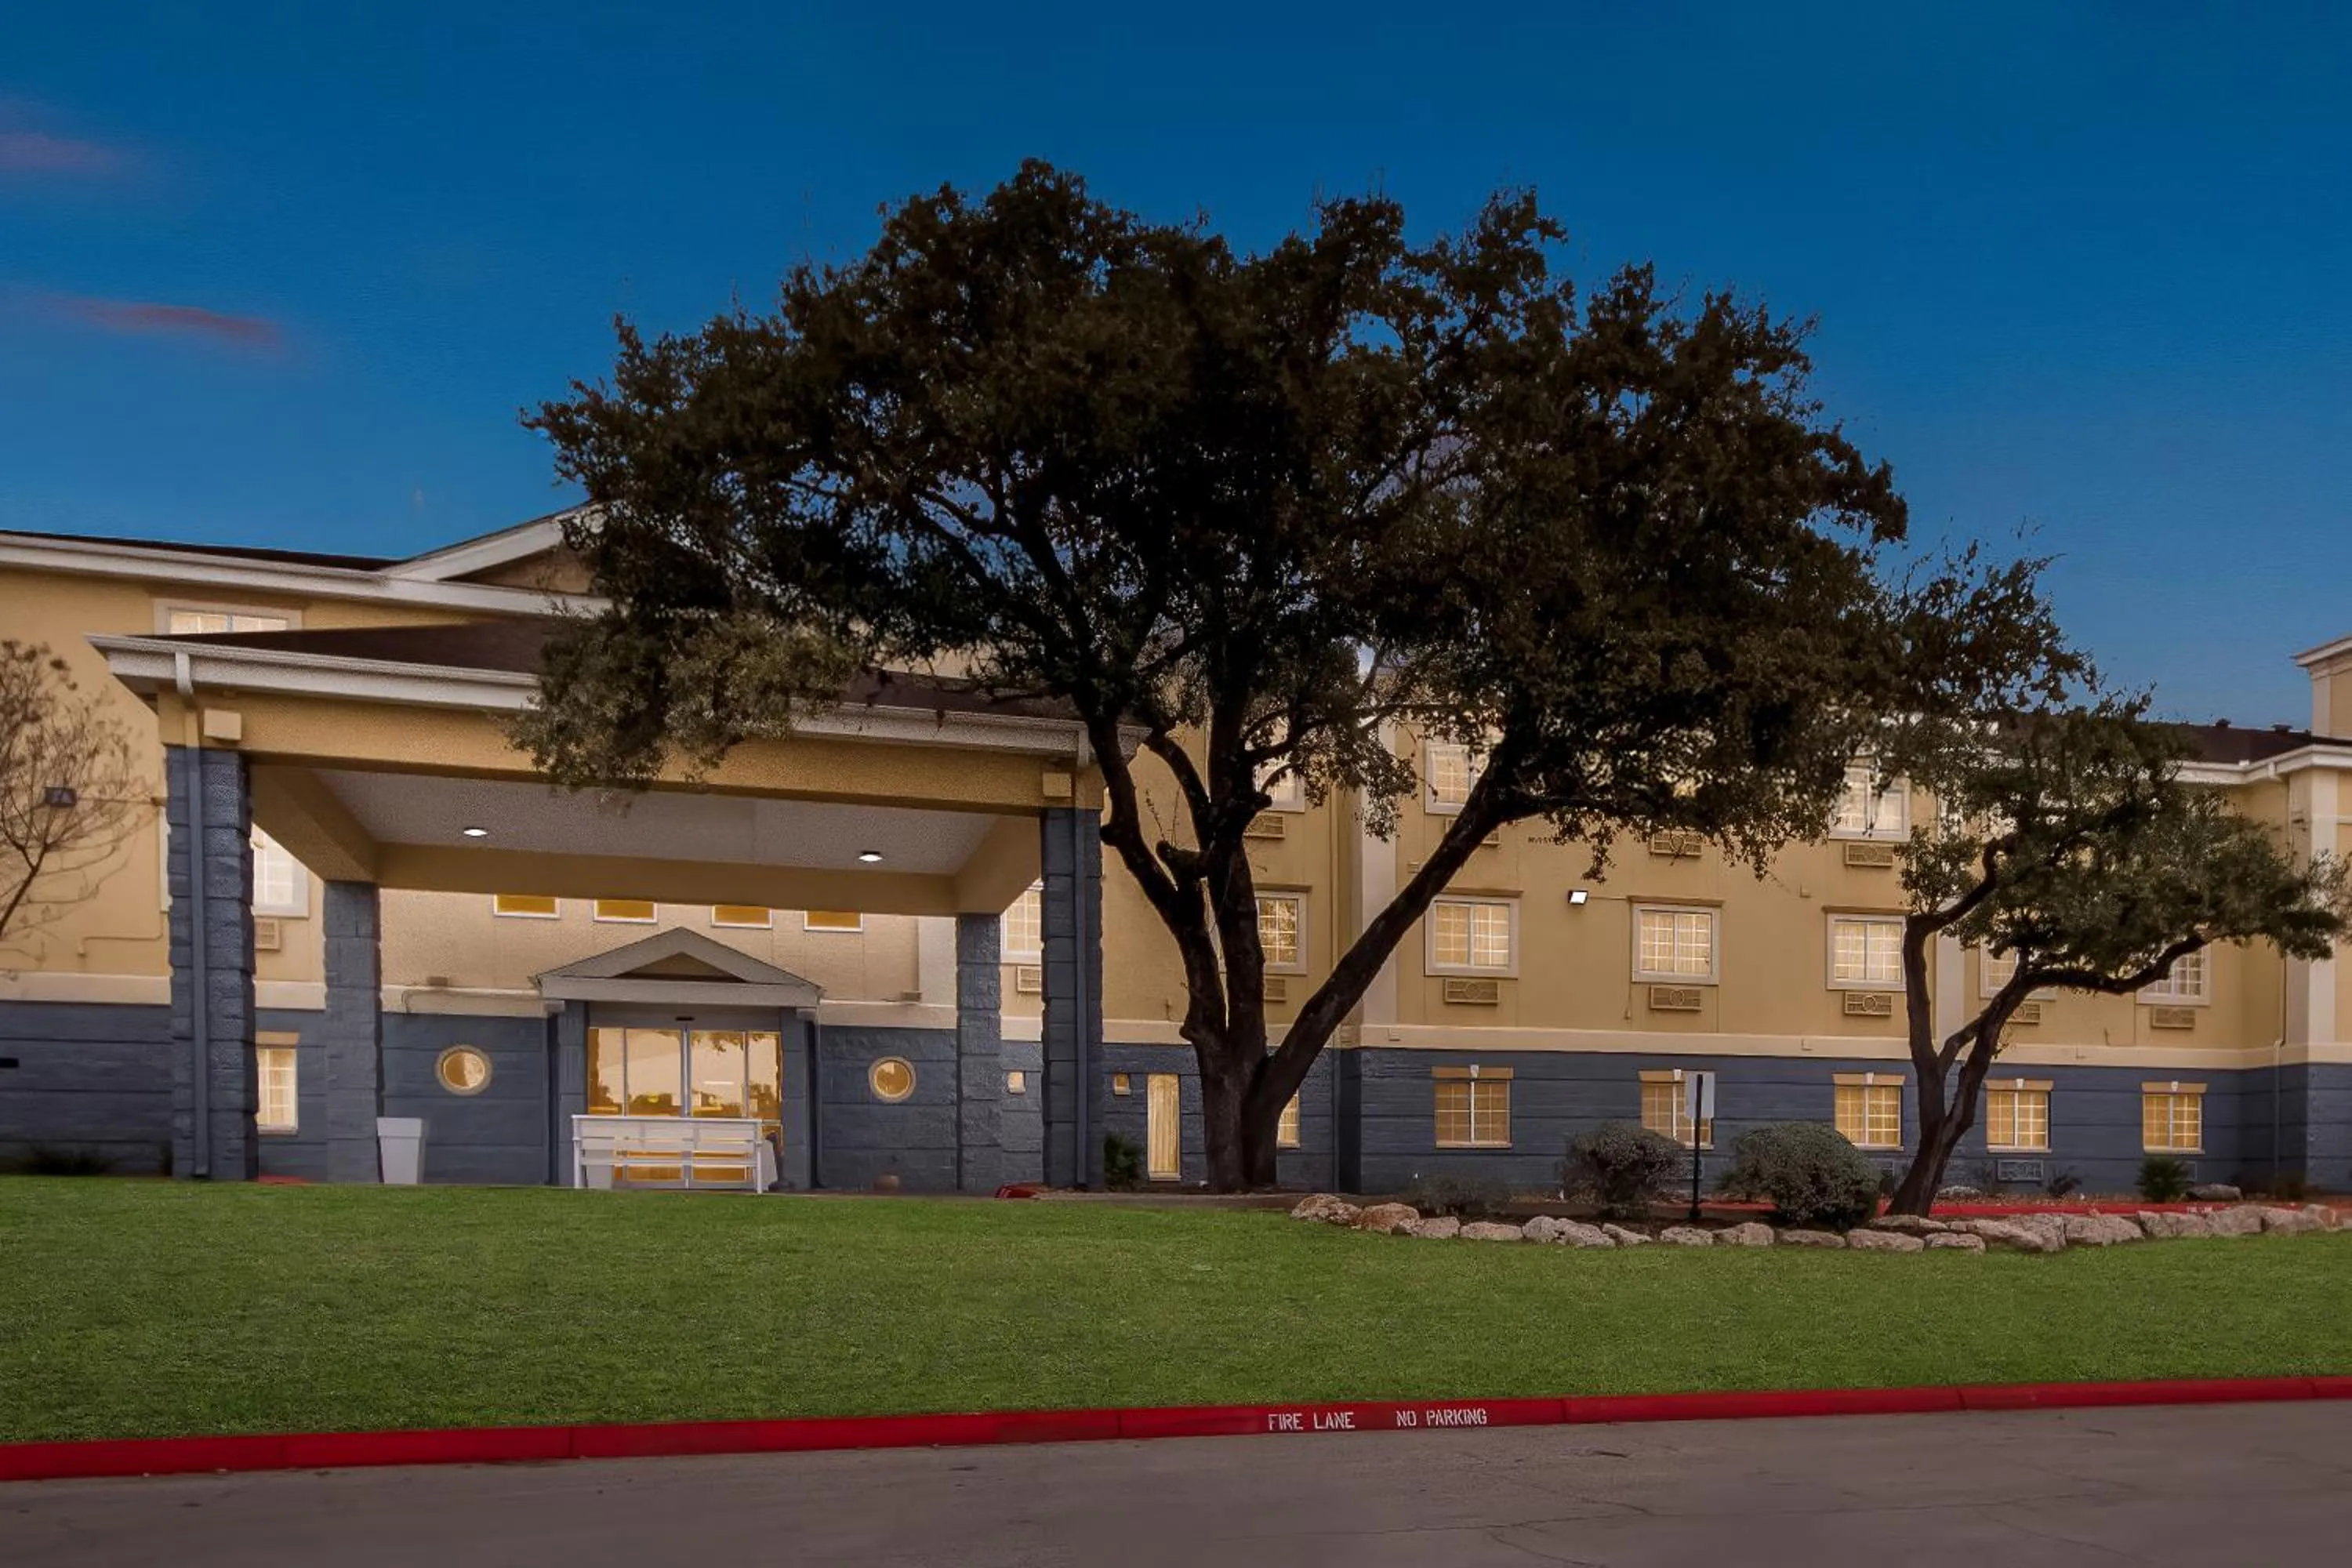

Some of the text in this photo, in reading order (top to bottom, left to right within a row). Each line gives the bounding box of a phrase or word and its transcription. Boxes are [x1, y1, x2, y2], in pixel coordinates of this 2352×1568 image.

[1268, 1408, 1487, 1431] FIRE LANE NO PARKING
